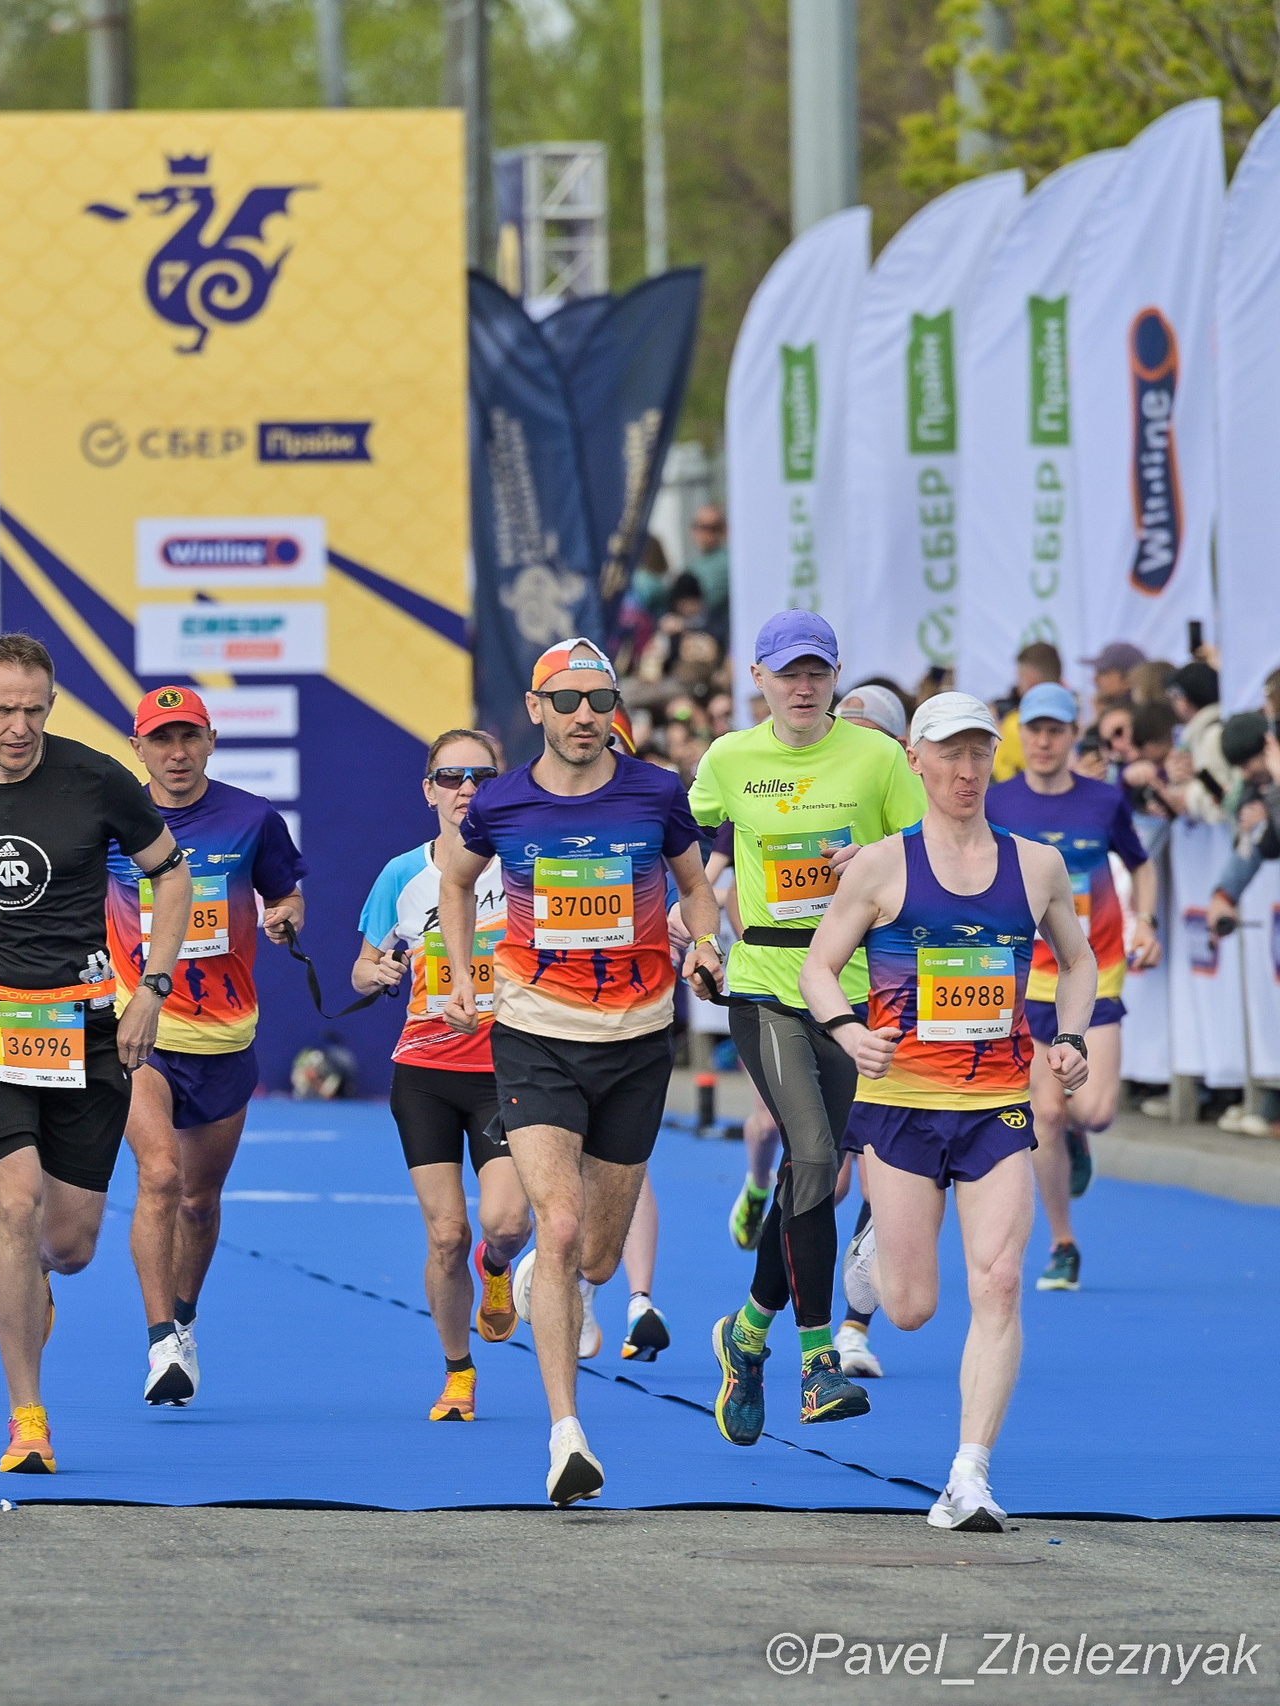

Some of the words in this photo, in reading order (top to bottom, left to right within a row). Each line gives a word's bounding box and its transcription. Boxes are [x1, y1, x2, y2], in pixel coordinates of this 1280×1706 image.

[1035, 316, 1067, 432] Прайм
[914, 332, 949, 442] Прайм
[137, 424, 247, 460] СБЕР
[918, 466, 959, 594] СБЕР
[1030, 460, 1066, 599] СБЕР
[743, 779, 795, 794] Achilles
[801, 802, 838, 811] Petersburg,
[780, 865, 841, 889] 3699
[550, 894, 622, 917] 37000
[935, 985, 1005, 1007] 36988
[7, 1036, 72, 1057] 36996
